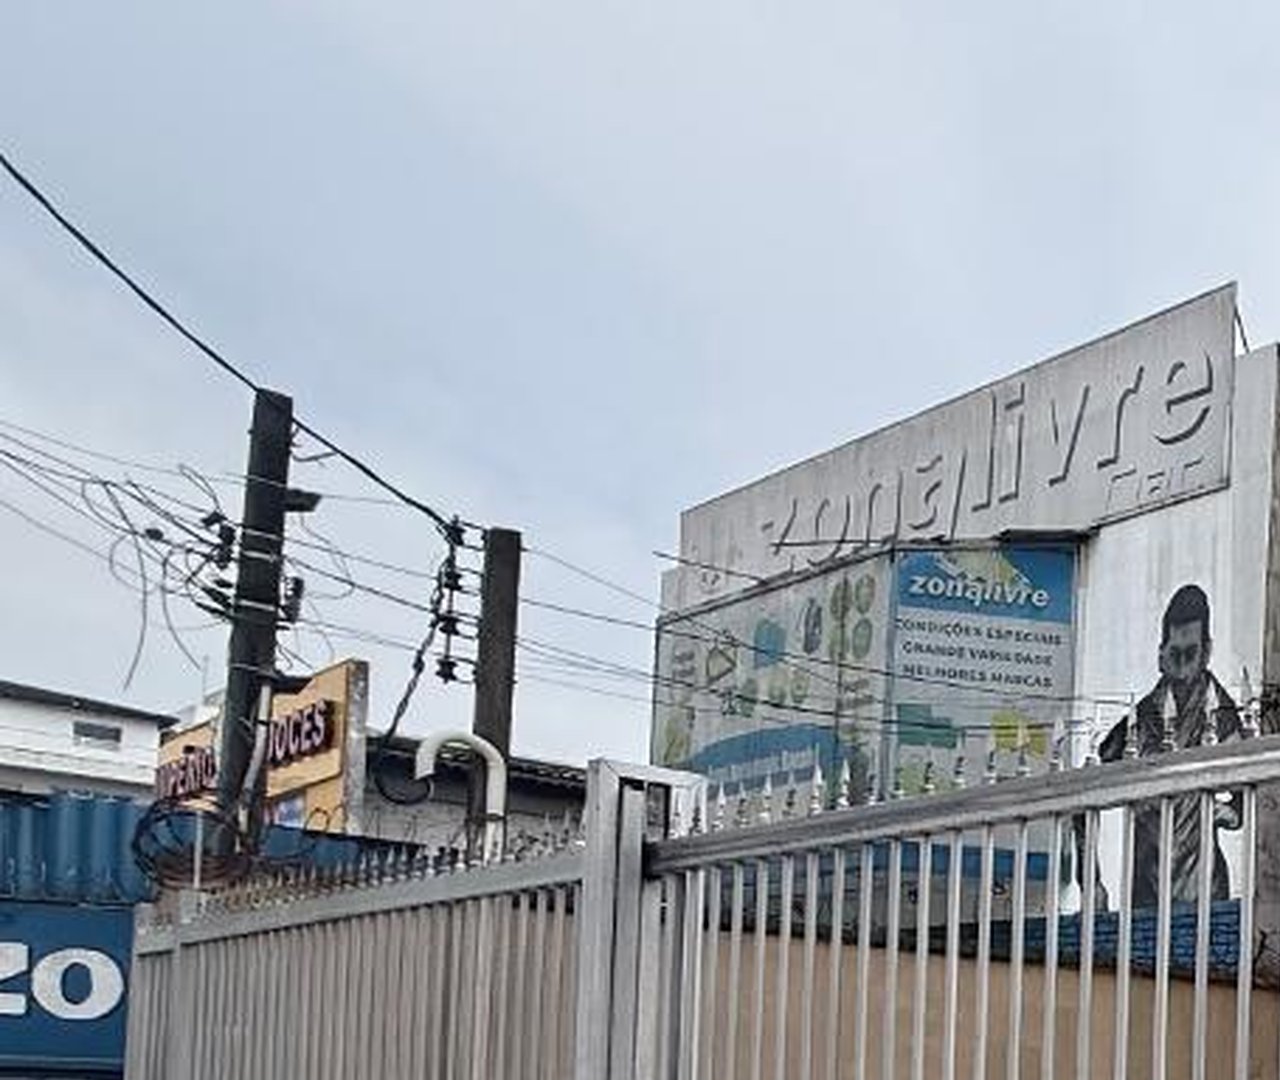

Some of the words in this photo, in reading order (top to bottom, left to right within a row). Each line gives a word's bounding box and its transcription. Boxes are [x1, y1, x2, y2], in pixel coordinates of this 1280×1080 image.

[908, 574, 1050, 607] zonalivre
[902, 641, 966, 659] GRANDE
[969, 648, 1053, 666] VARIEDADE
[902, 664, 987, 683] MELHORES
[991, 672, 1053, 688] MARCAS
